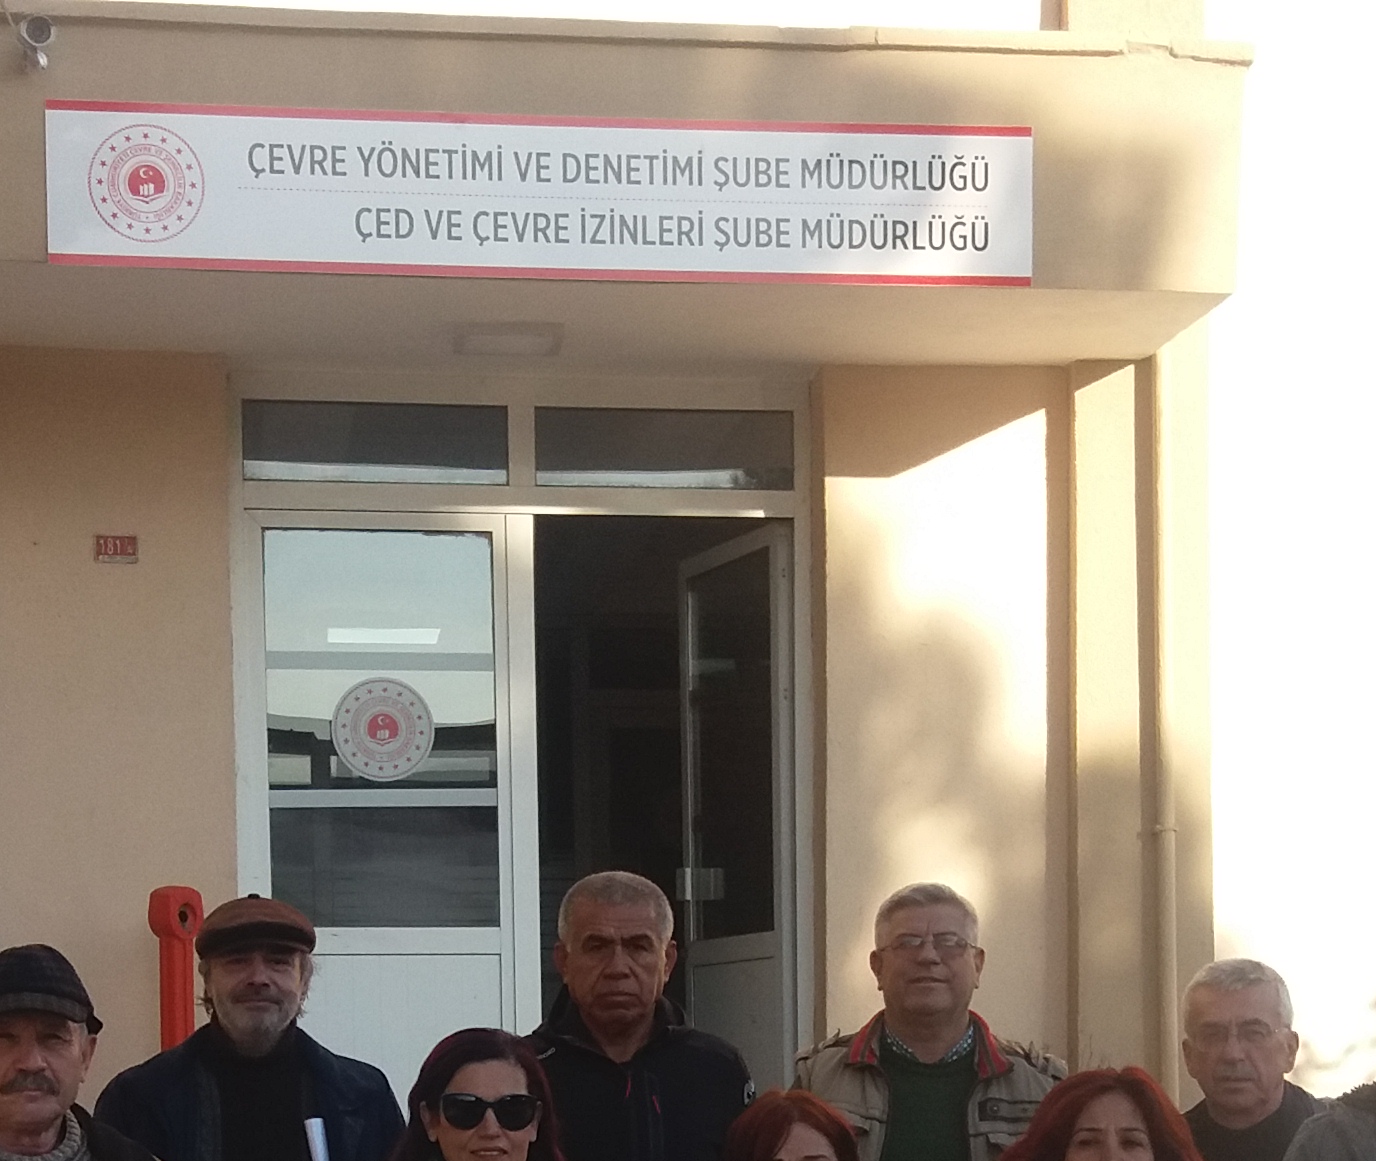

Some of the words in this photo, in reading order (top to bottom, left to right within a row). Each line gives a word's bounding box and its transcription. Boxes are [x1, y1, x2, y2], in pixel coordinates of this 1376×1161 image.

[247, 142, 347, 179] ÇEVRE
[356, 140, 503, 182] YÖNETİMİ
[513, 151, 552, 183] VE
[561, 149, 703, 187] DENETİMİ
[713, 156, 791, 192] ŞUBE
[800, 152, 990, 192] MÜDÜRLÜĞÜ
[354, 207, 414, 243] ÇED
[424, 209, 462, 241] VE
[472, 210, 570, 247] ÇEVRE
[579, 207, 704, 247] İZİNLERİ
[713, 216, 791, 252] ŞUBE
[800, 212, 990, 252] MÜDÜRLÜĞÜ
